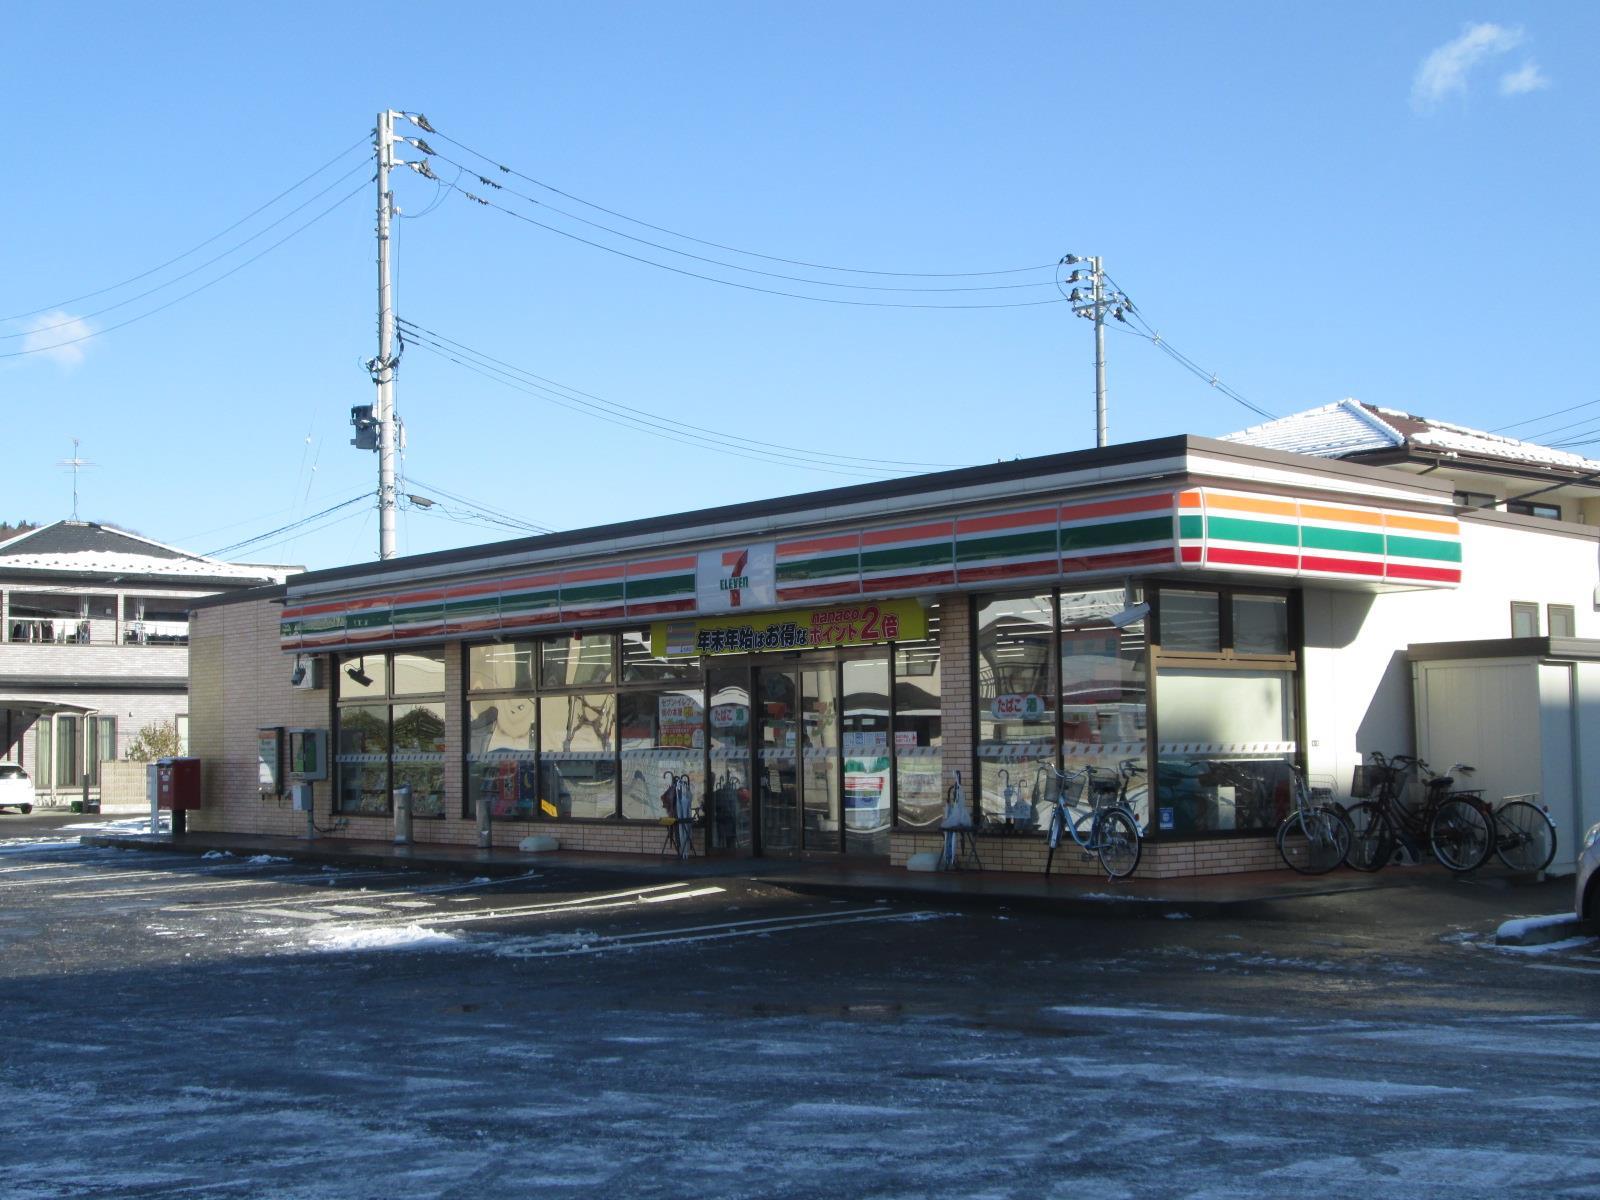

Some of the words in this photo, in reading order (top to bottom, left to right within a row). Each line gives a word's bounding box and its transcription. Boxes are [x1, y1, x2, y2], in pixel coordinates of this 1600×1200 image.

[810, 609, 860, 626] nanaco
[697, 623, 808, 652] 年末年始はお得な
[997, 697, 1022, 713] たばこ
